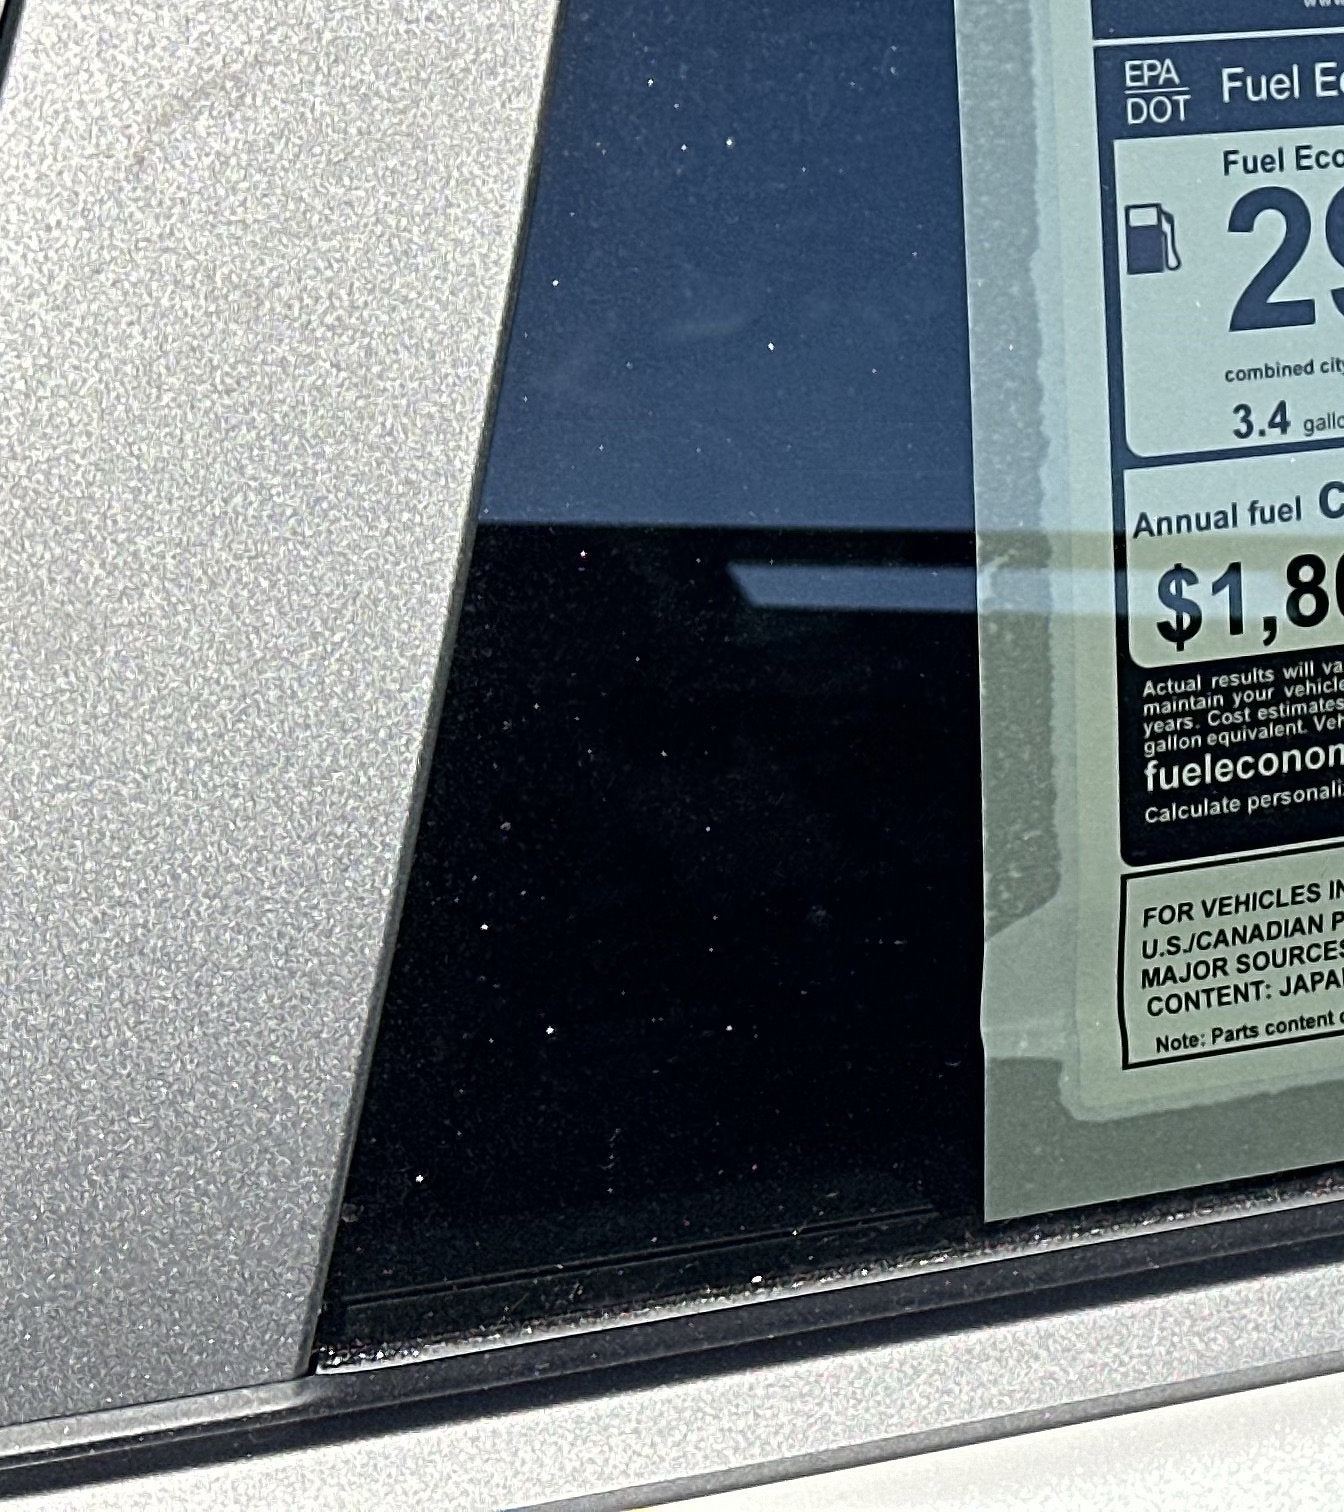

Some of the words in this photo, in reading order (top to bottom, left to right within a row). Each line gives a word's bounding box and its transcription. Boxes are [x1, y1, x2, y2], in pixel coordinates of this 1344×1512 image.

[1124, 58, 1181, 88] EPA
[1221, 63, 1300, 104] Fuel
[1126, 94, 1192, 126] DOT
[1222, 146, 1285, 177] Fuel
[1224, 358, 1315, 383] combined
[1232, 399, 1292, 440] 3.4
[1131, 501, 1238, 540] Annual
[1247, 494, 1302, 527] fuel
[1144, 796, 1241, 824] Calculate
[1142, 901, 1195, 929] FOR
[1200, 882, 1322, 919] VEHICLES
